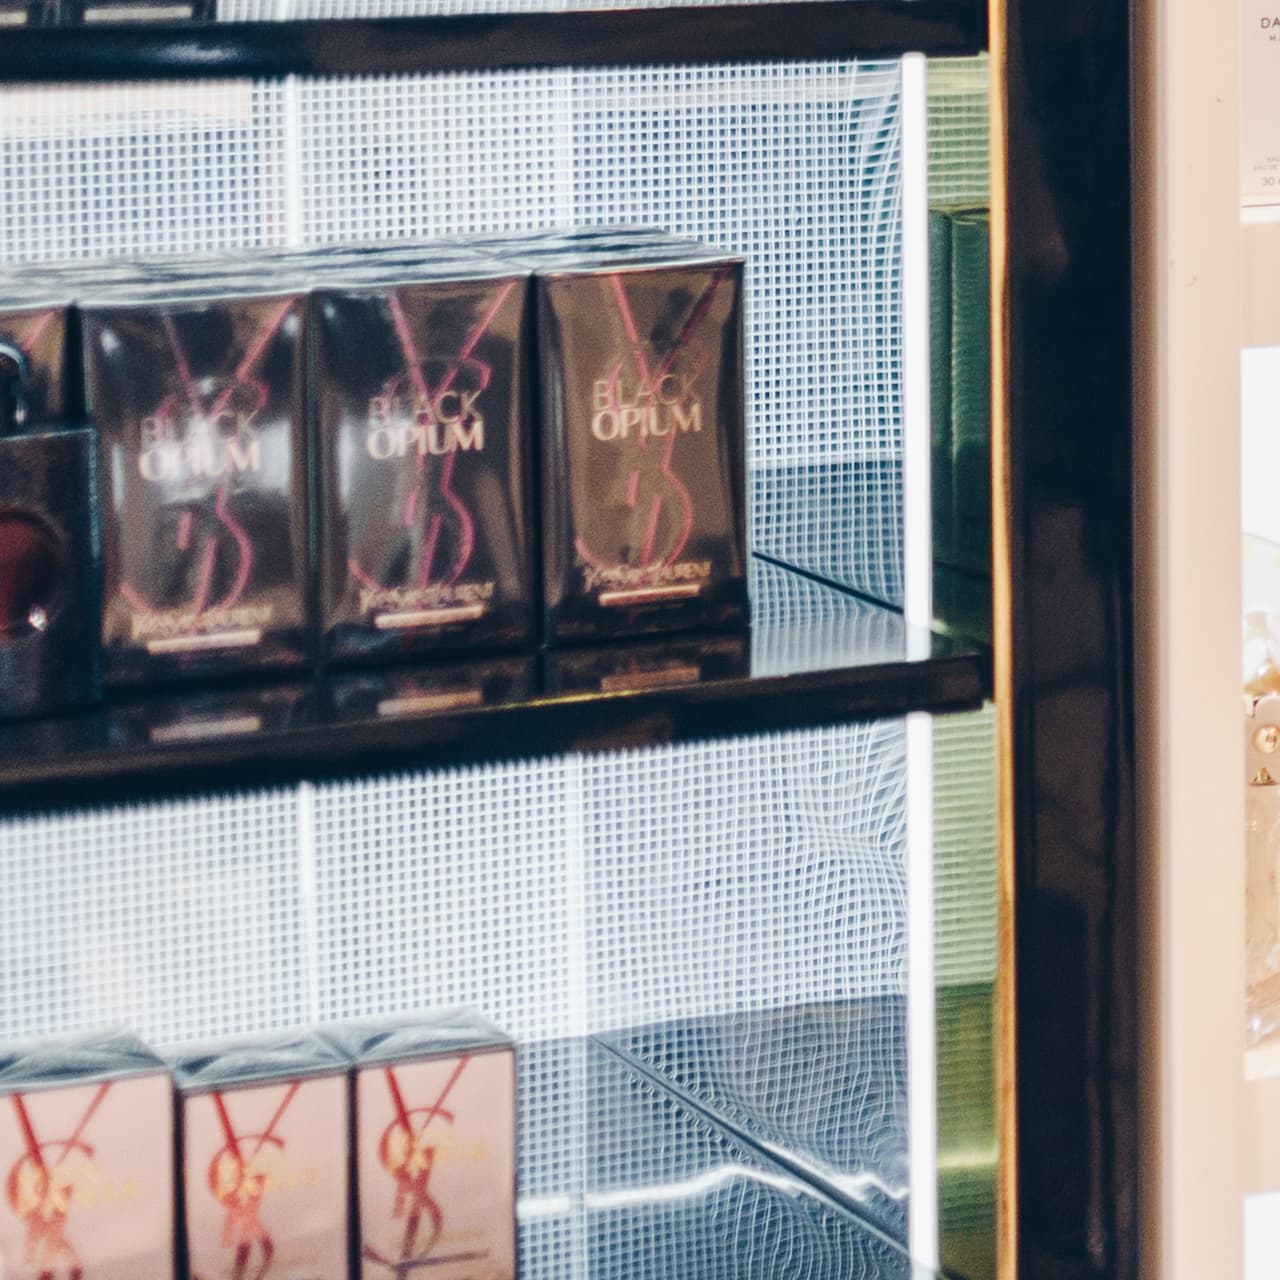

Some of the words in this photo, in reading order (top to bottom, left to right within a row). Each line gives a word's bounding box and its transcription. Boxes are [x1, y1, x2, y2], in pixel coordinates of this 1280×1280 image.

[592, 370, 701, 412] BLACK
[366, 419, 486, 461] OPIUM
[590, 402, 703, 441] OPIUM
